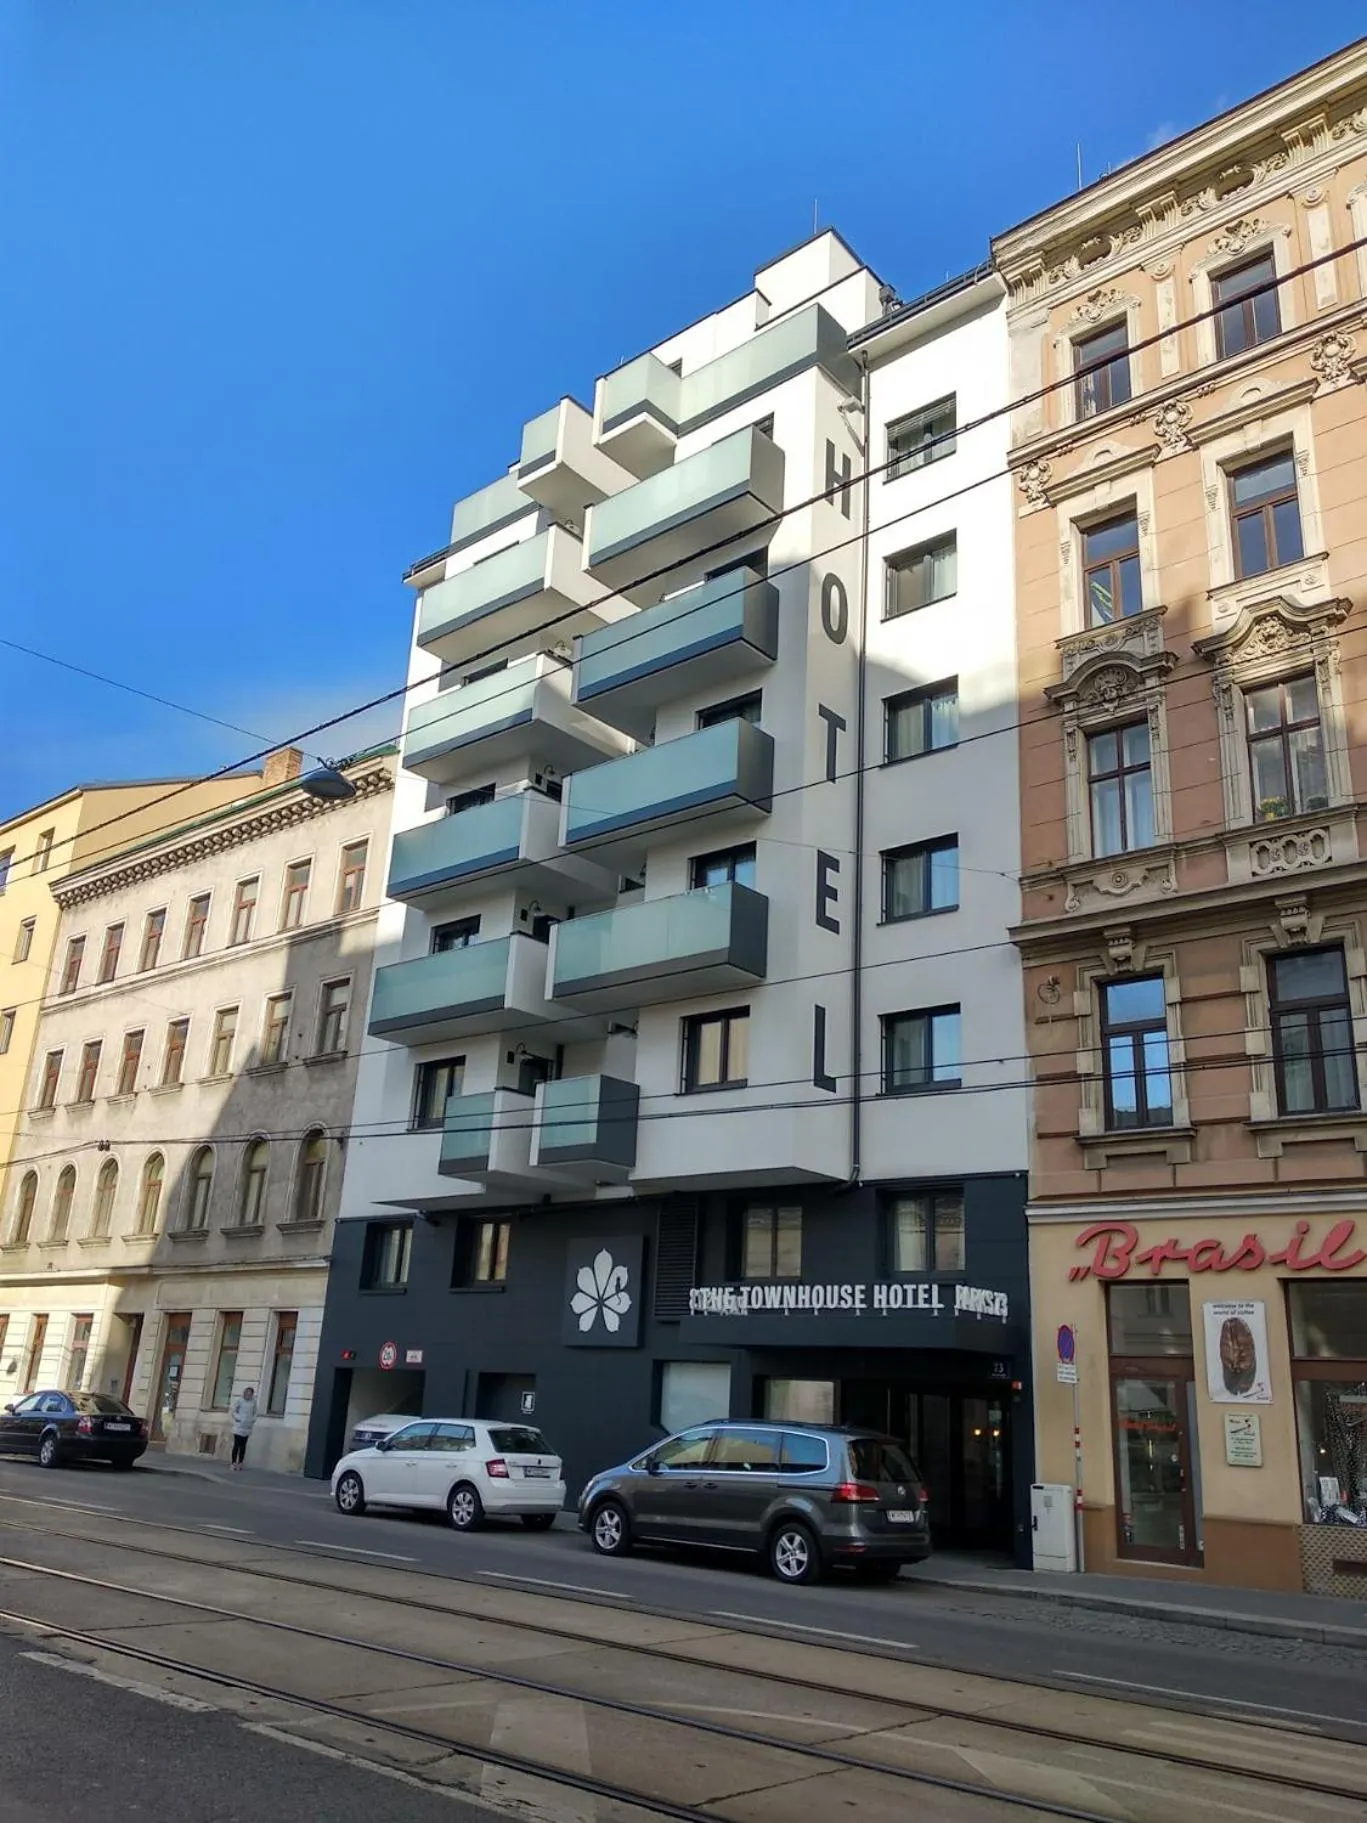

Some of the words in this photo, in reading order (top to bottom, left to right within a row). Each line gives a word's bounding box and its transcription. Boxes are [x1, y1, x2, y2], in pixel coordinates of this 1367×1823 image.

[813, 438, 852, 1093] HOTEL
[740, 1285, 867, 1309] TOWNHOUSE
[873, 1284, 944, 1309] HOTEL
